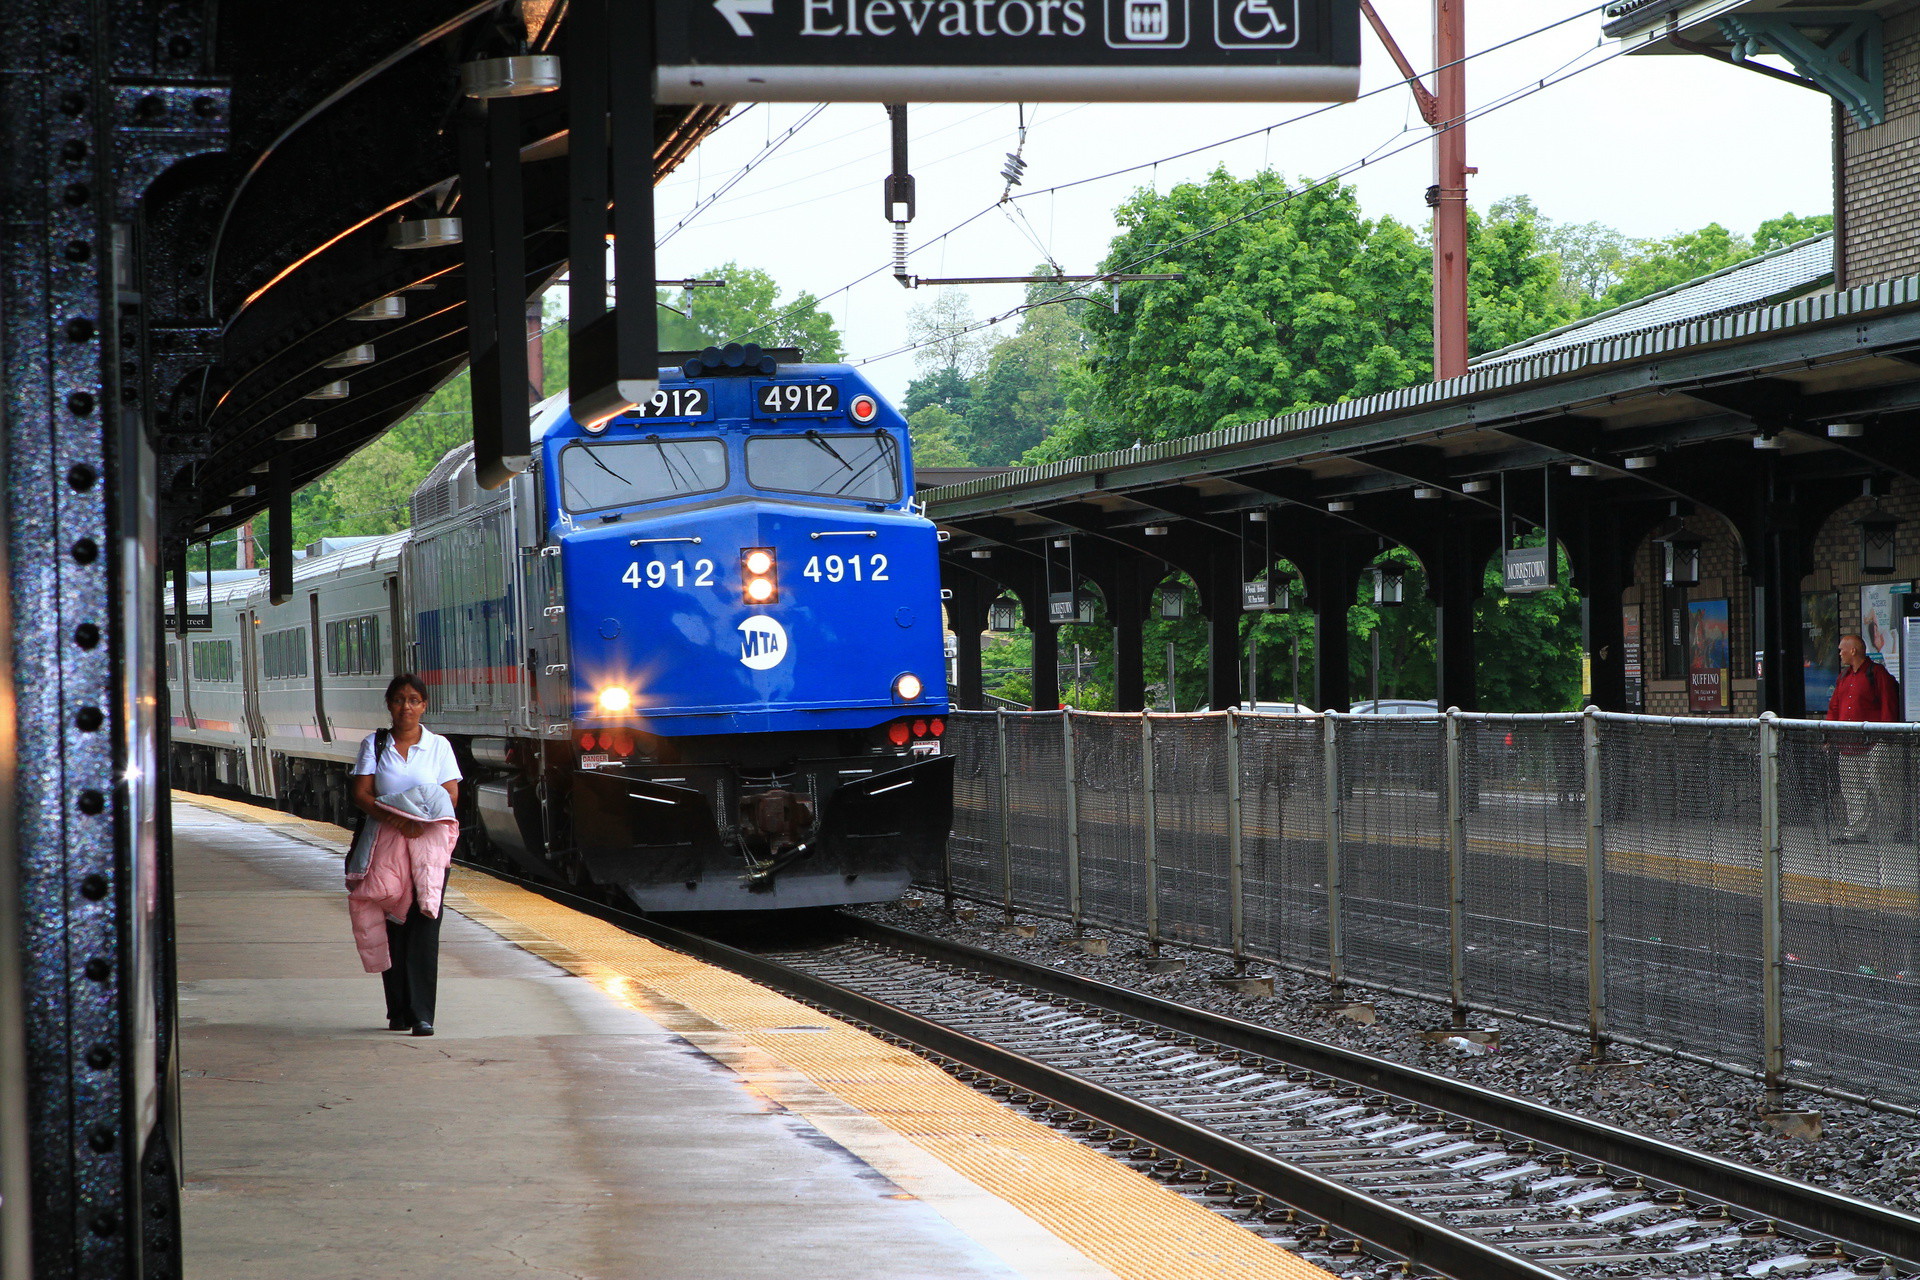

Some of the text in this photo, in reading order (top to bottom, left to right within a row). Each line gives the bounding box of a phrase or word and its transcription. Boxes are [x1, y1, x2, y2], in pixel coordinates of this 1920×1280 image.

[800, 0, 1086, 36] Elevators
[764, 385, 833, 412] 4912
[621, 558, 715, 589] 4912
[803, 554, 889, 583] 4912
[1507, 561, 1545, 579] MORRISTOWN
[740, 630, 779, 660] MTA
[1692, 673, 1719, 686] RUFFINO
